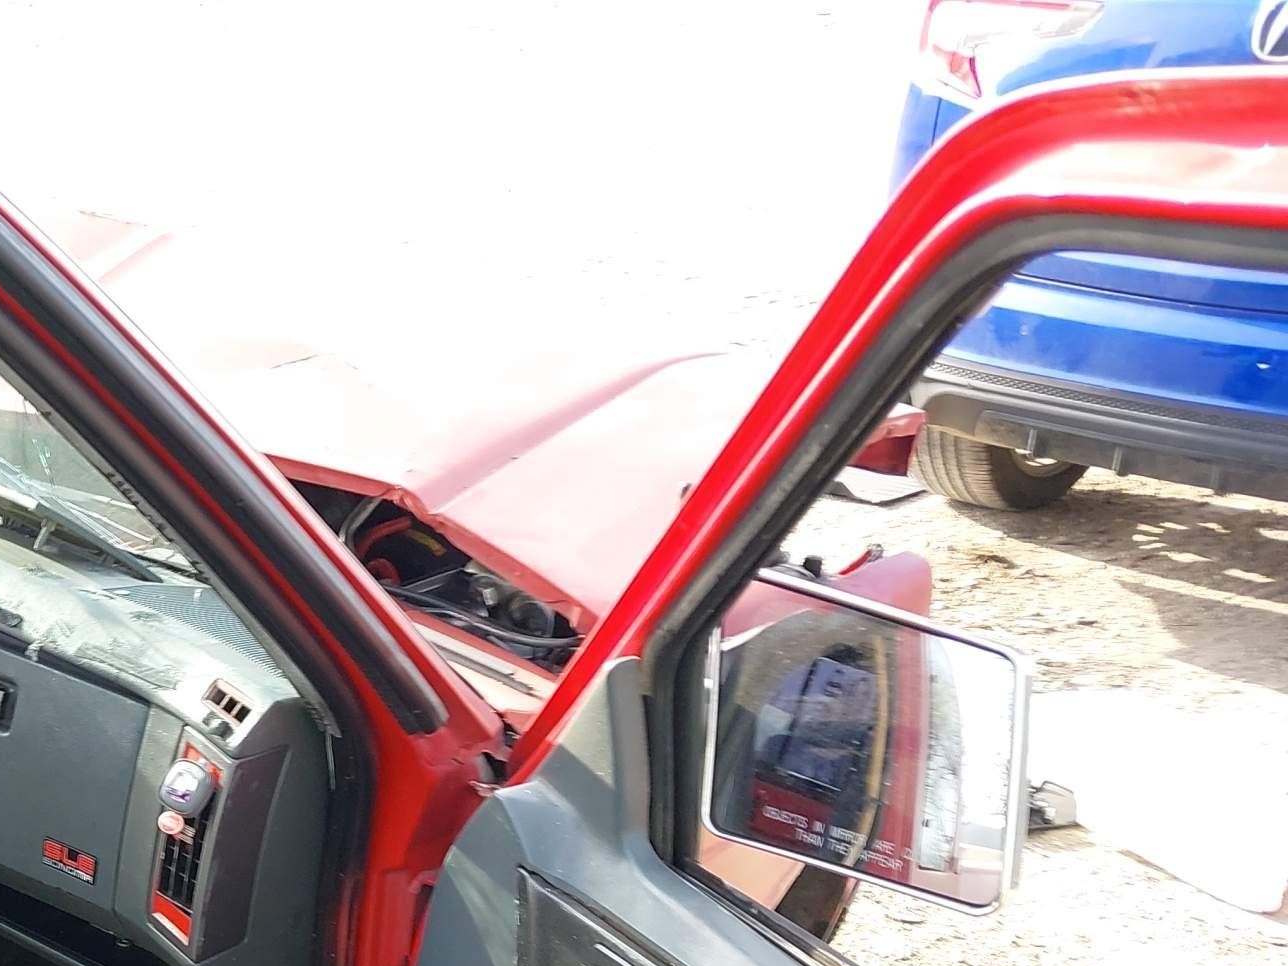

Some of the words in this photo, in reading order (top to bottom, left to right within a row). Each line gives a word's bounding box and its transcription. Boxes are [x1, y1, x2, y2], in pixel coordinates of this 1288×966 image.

[762, 805, 808, 828] OBJECTS
[813, 820, 825, 834] IN
[871, 840, 896, 856] ARE
[794, 827, 825, 849] THAN
